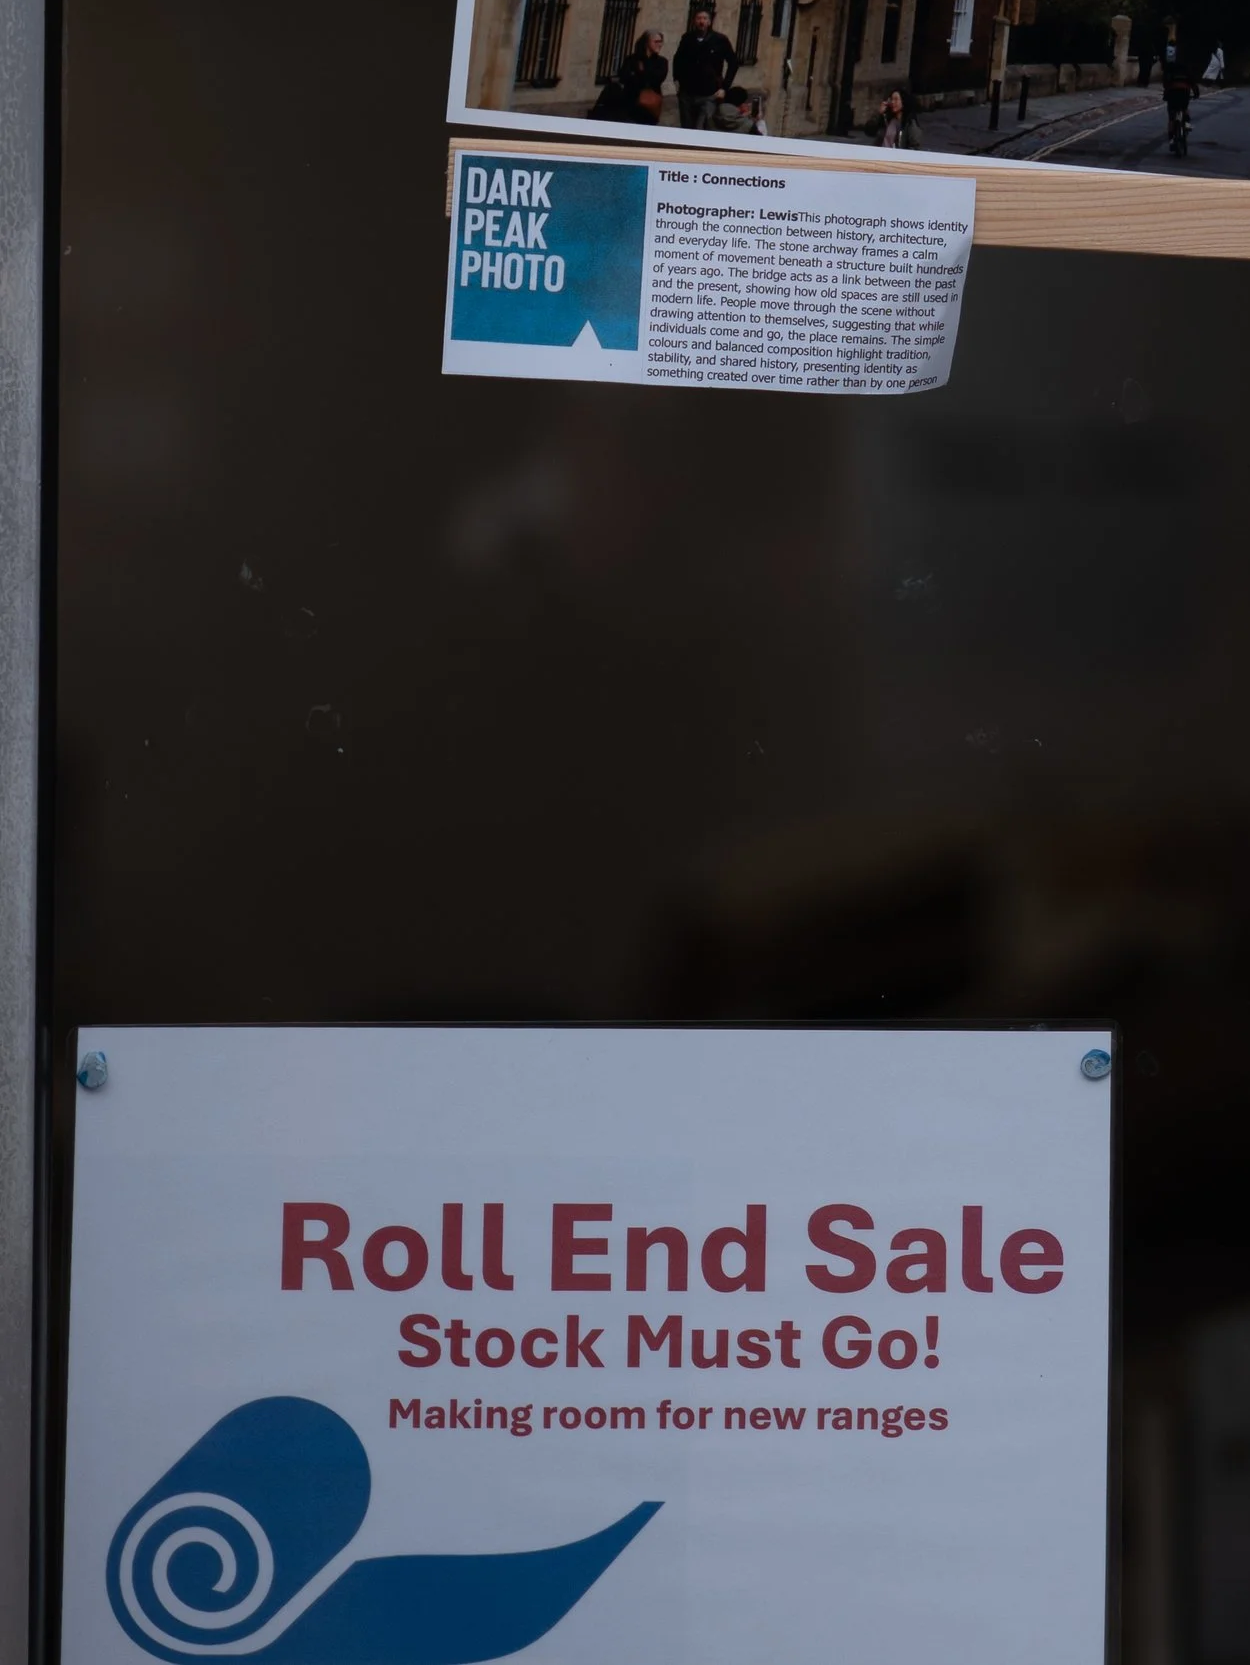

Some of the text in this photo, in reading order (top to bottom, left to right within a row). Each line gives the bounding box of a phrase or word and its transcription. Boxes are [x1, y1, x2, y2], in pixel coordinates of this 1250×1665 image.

[466, 166, 553, 208] DARK
[658, 169, 690, 183] Title
[701, 172, 786, 189] Connections
[464, 208, 548, 250] PEAK
[656, 202, 755, 219] Photographer:
[824, 213, 887, 229] photograph
[890, 217, 925, 230] shows
[927, 219, 969, 234] identity
[655, 218, 947, 247] through the connection between history, architecture,
[654, 233, 938, 260] and everyday life. The stone archway frames a calm
[461, 250, 565, 292] PHOTO
[654, 249, 964, 275] moment of movement beneath a structure built hundreds
[651, 277, 959, 303] and the present, showing how old spaces are still used in
[652, 262, 957, 291] of years ago. The bridge acts as a link between the past
[651, 293, 936, 317] modern life. People move through the scene without
[649, 306, 945, 333] drawing attention to themselves, suggesting that while
[649, 322, 946, 347] individuals come and go, the place remains. The simple
[648, 337, 931, 361] colours and balanced composition highlight tradition,
[647, 352, 918, 375] stability, and shared history, presenting identity as
[646, 367, 938, 390] something created over time rather than by one person
[282, 1203, 1063, 1294] Roll End Sale
[399, 1314, 939, 1369] Stock Must Go!
[390, 1399, 947, 1437] Making room for new ranges
